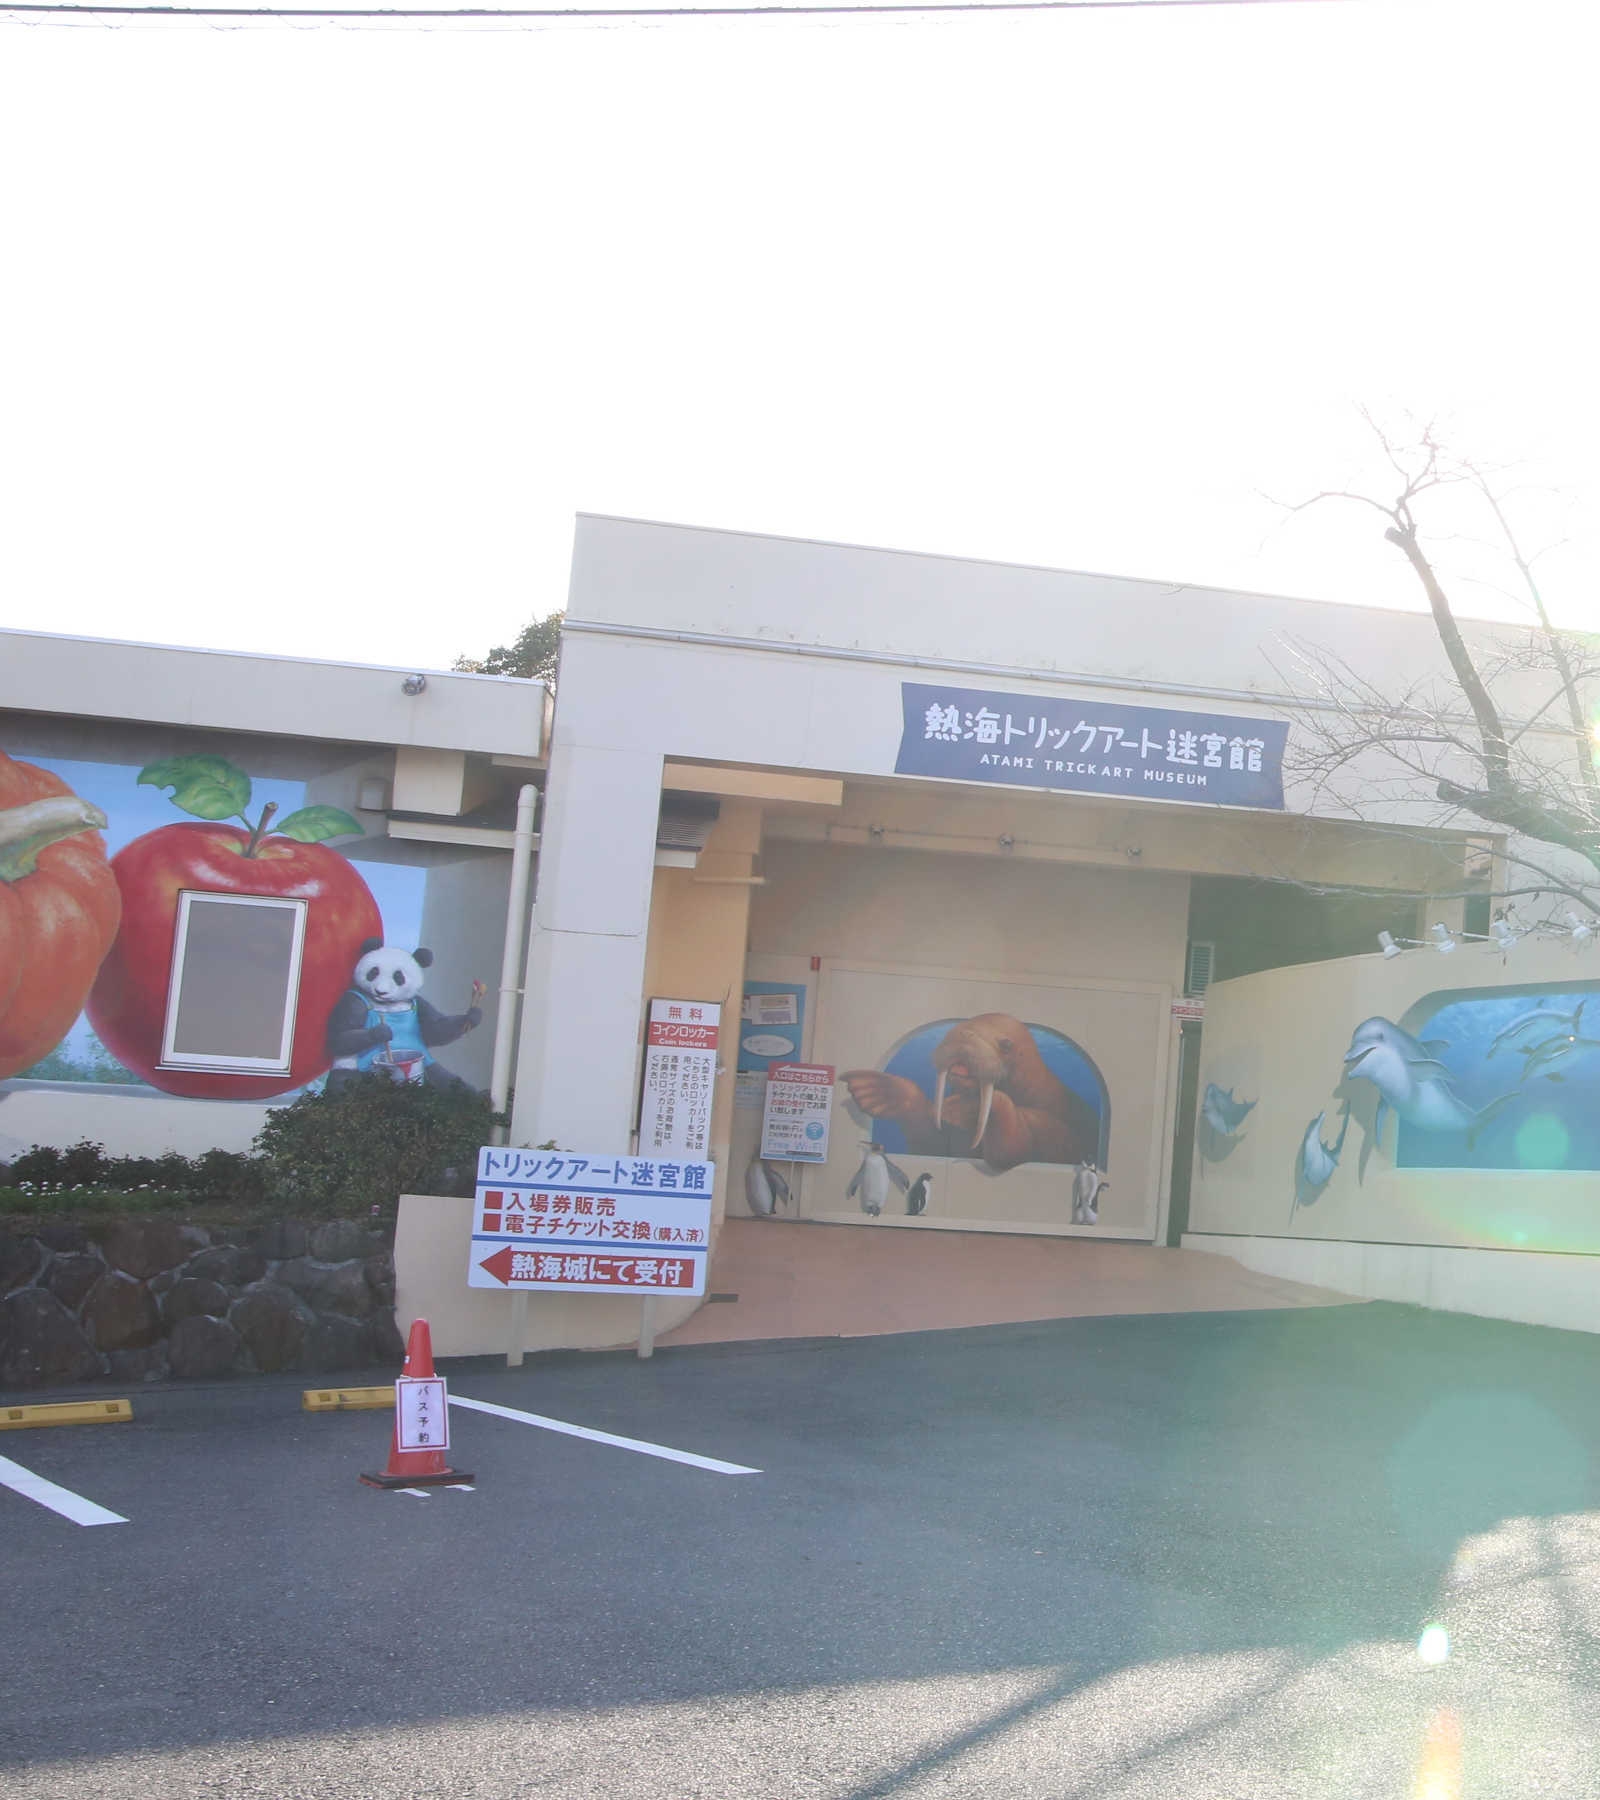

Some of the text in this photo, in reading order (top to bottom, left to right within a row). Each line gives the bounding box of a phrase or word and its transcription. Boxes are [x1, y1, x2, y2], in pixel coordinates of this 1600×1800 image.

[925, 703, 1264, 772] 熱海トリックアート迷宮館
[980, 754, 1034, 770] ATAMI
[1144, 769, 1208, 786] MUSEUM
[652, 1024, 716, 1038] コインロッカー
[484, 1151, 707, 1190] トリックアート迷宮館
[507, 1193, 616, 1216] 入場券販売
[510, 1254, 684, 1285] 熱海城にて受付
[417, 1385, 430, 1443] バス予約
